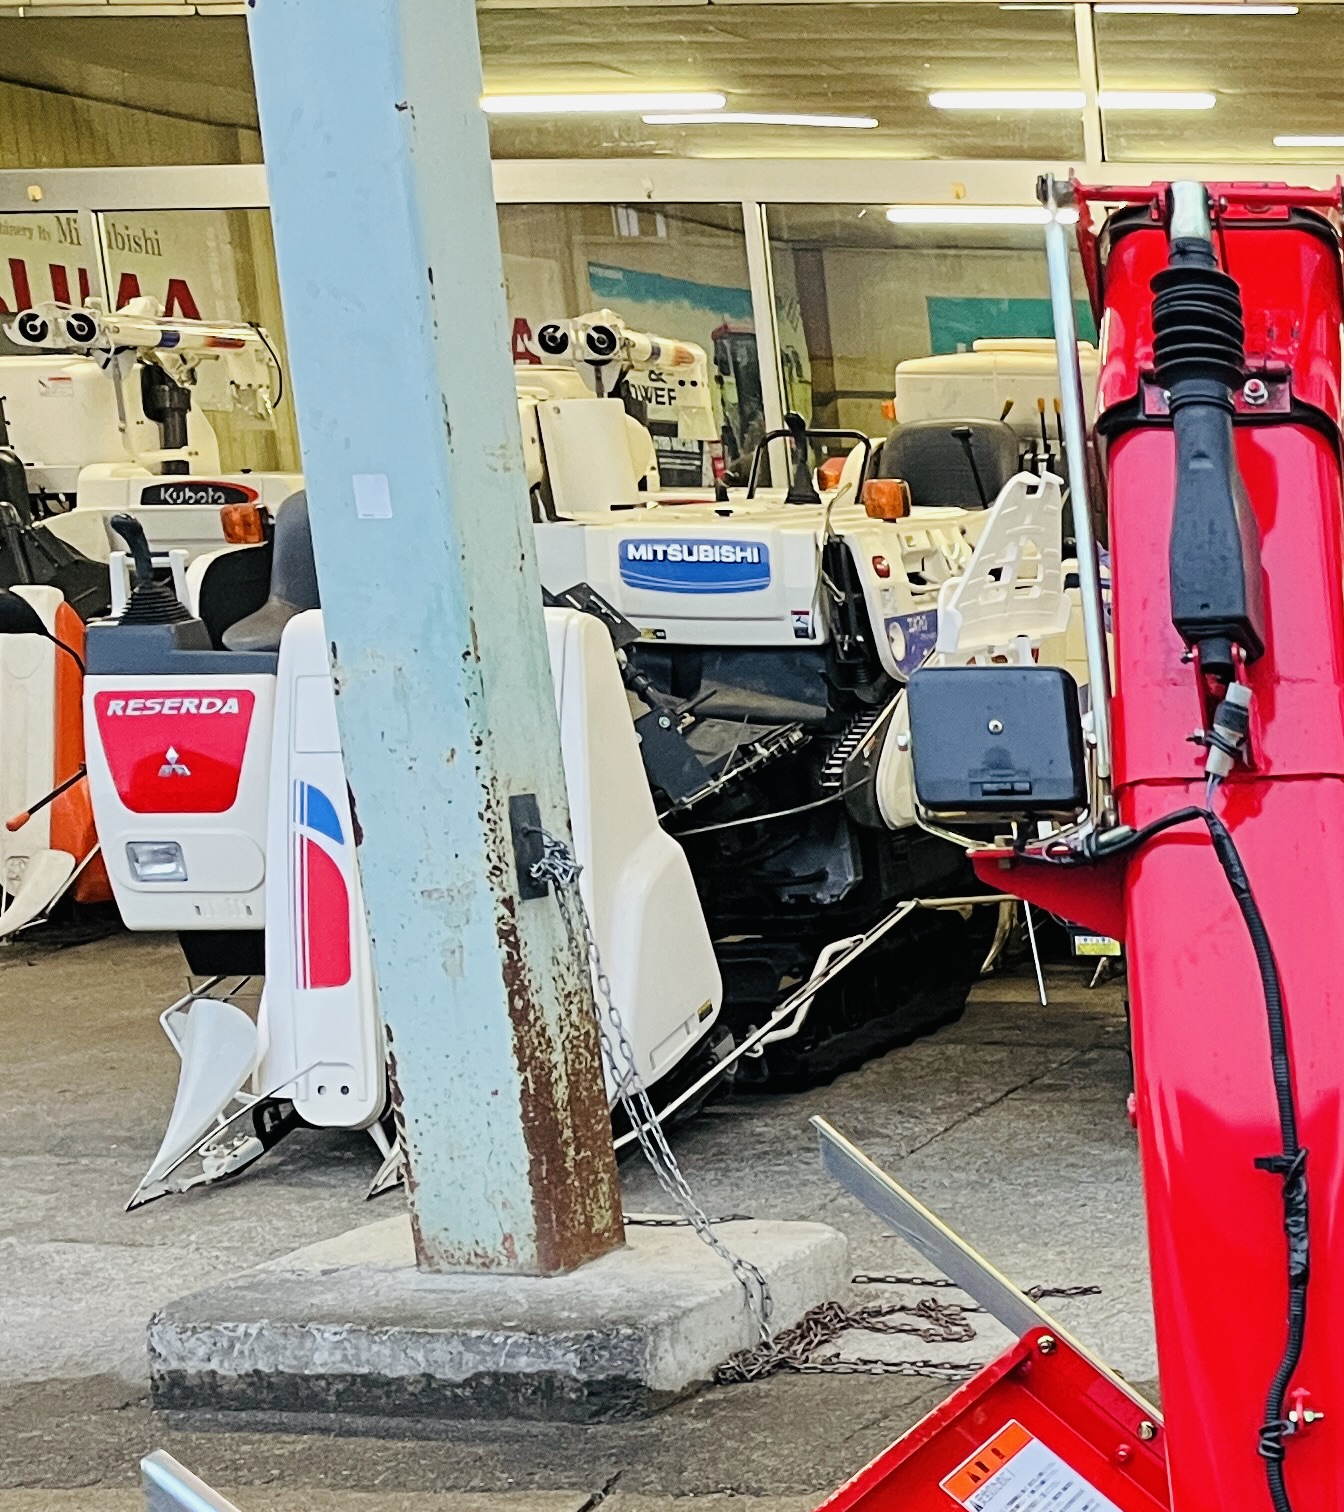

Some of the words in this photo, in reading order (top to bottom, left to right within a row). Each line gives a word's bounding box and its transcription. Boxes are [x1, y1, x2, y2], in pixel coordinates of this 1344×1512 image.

[54, 215, 163, 257] Mibishi
[160, 487, 225, 504] Kubota
[627, 543, 761, 564] MITSUBISHI
[107, 698, 239, 717] RESERDA
